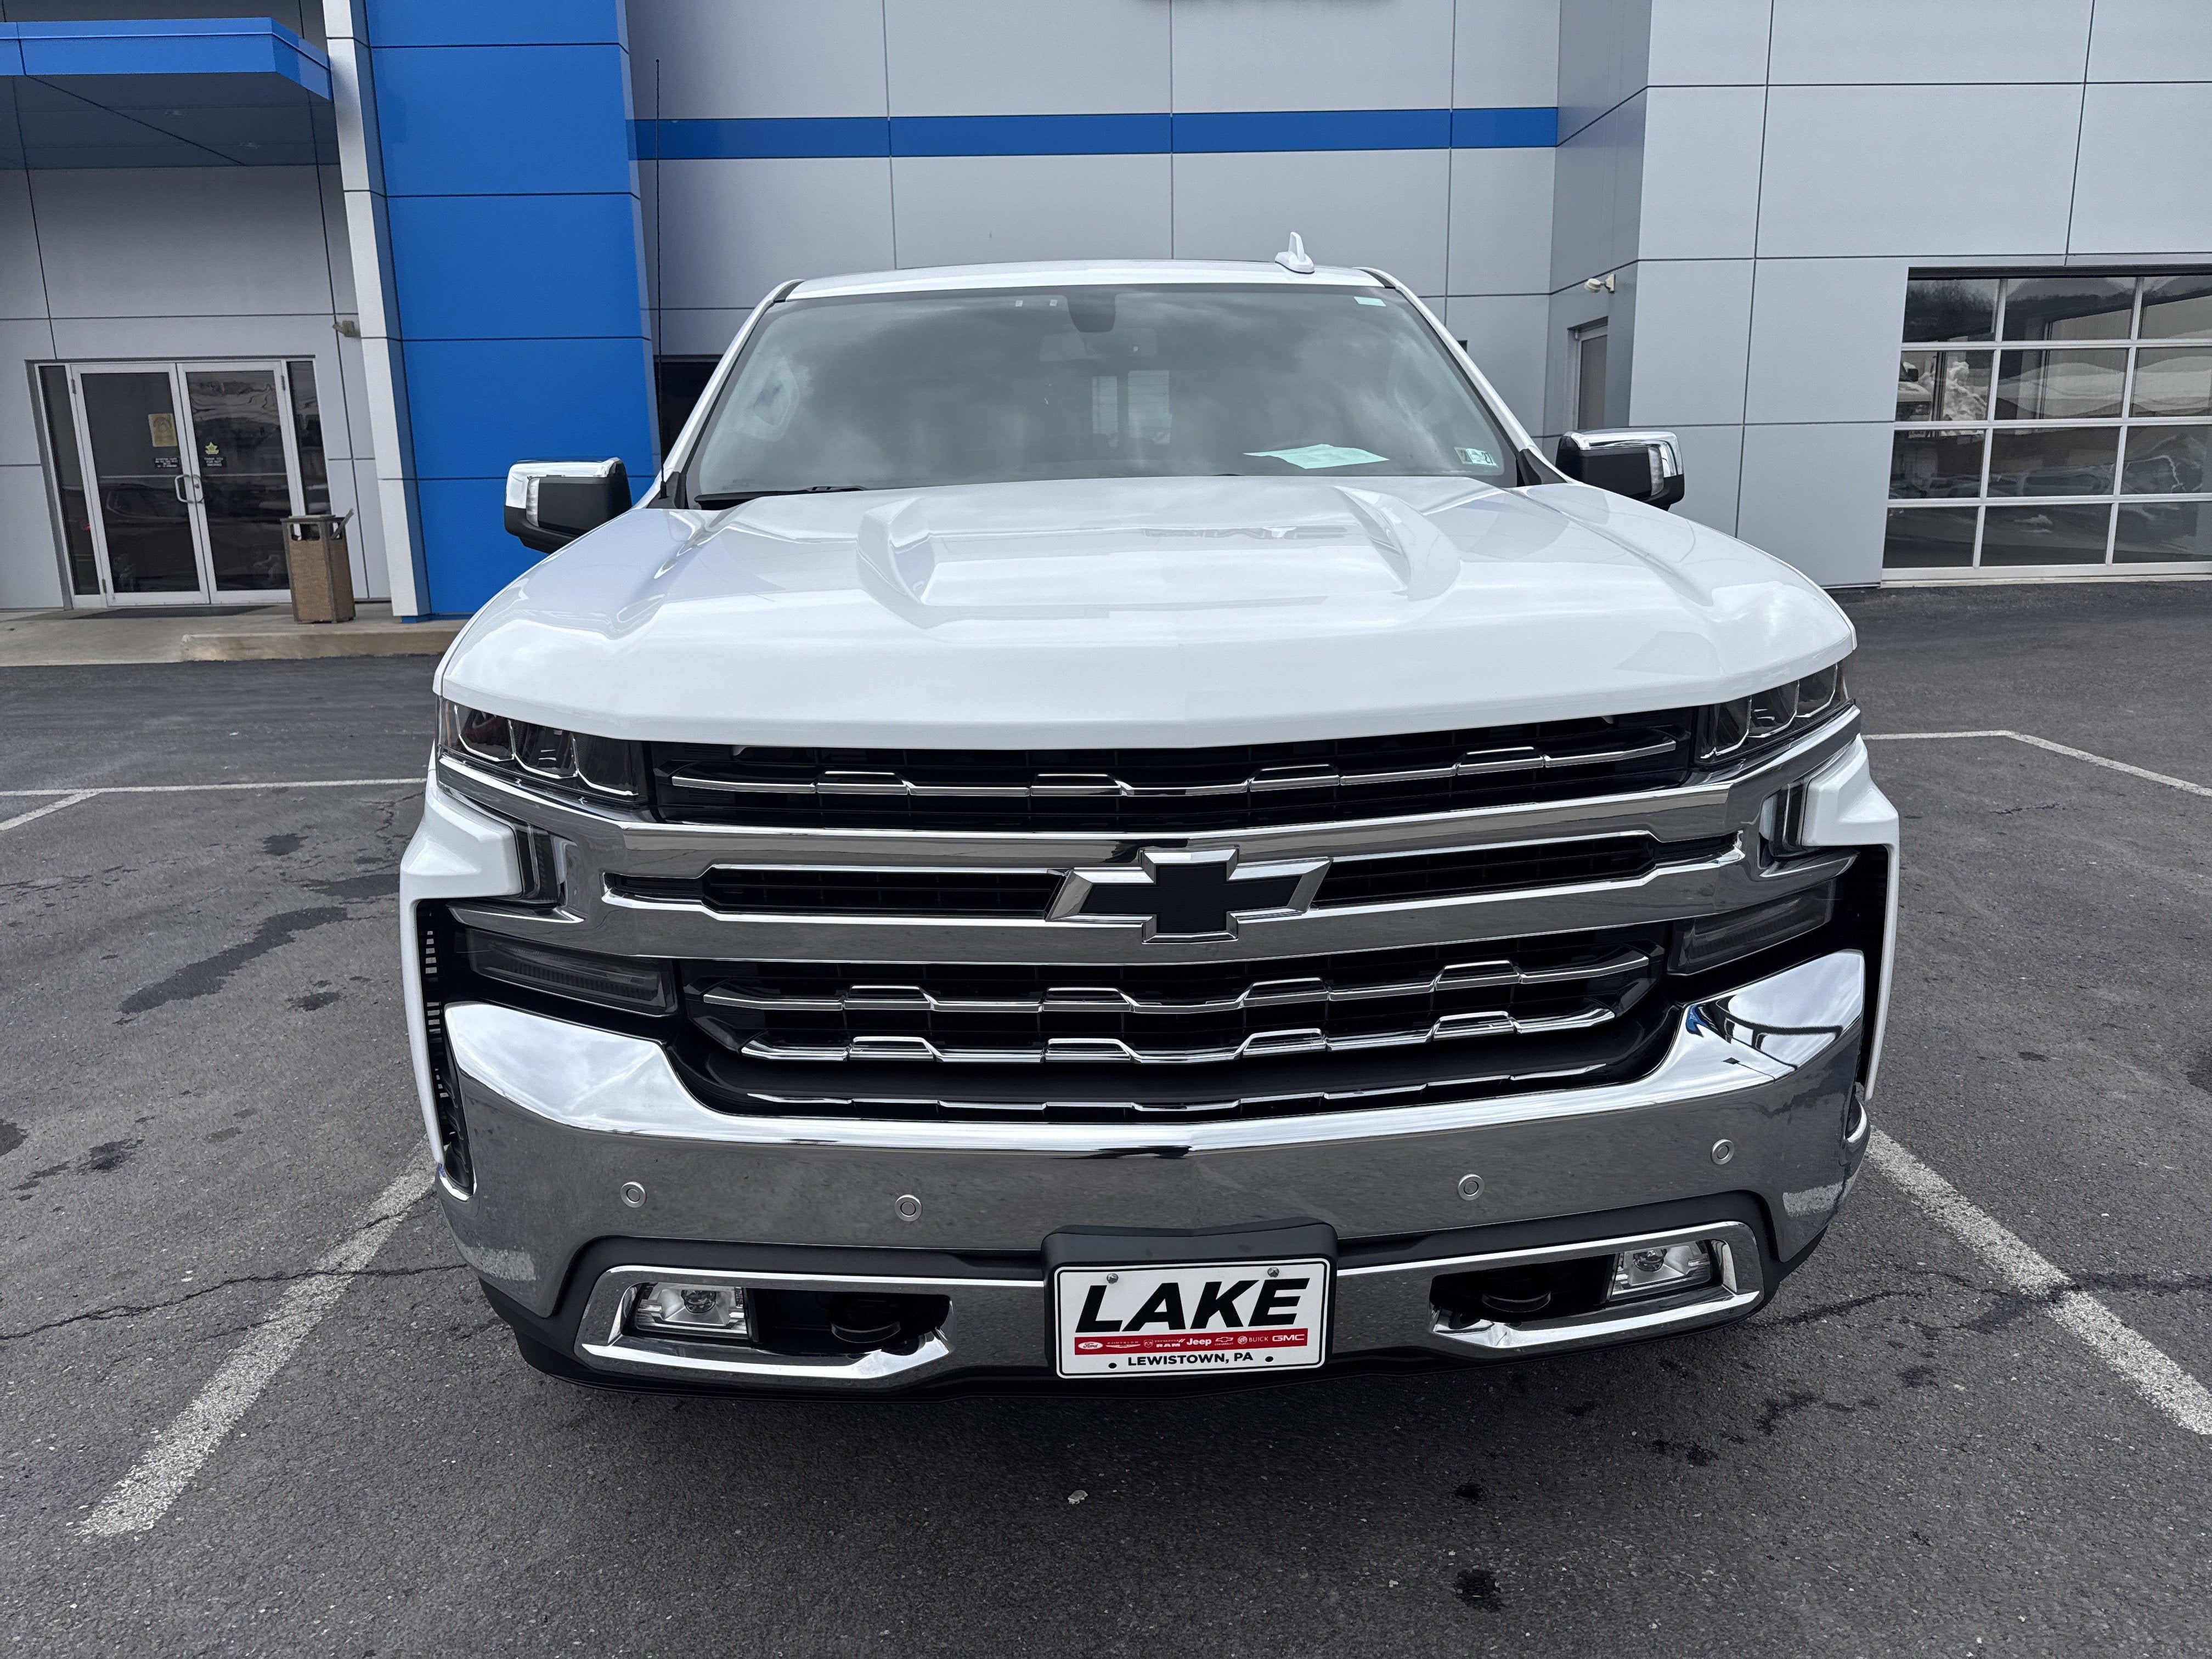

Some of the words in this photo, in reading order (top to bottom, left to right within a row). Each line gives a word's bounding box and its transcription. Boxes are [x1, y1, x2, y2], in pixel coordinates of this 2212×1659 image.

[1075, 1278, 1310, 1333] LAKE
[1186, 1338, 1212, 1346] Jeep
[1272, 1334, 1305, 1342] GMC
[1128, 1353, 1229, 1365] LEWISTOWN,
[1234, 1352, 1254, 1362] PA
